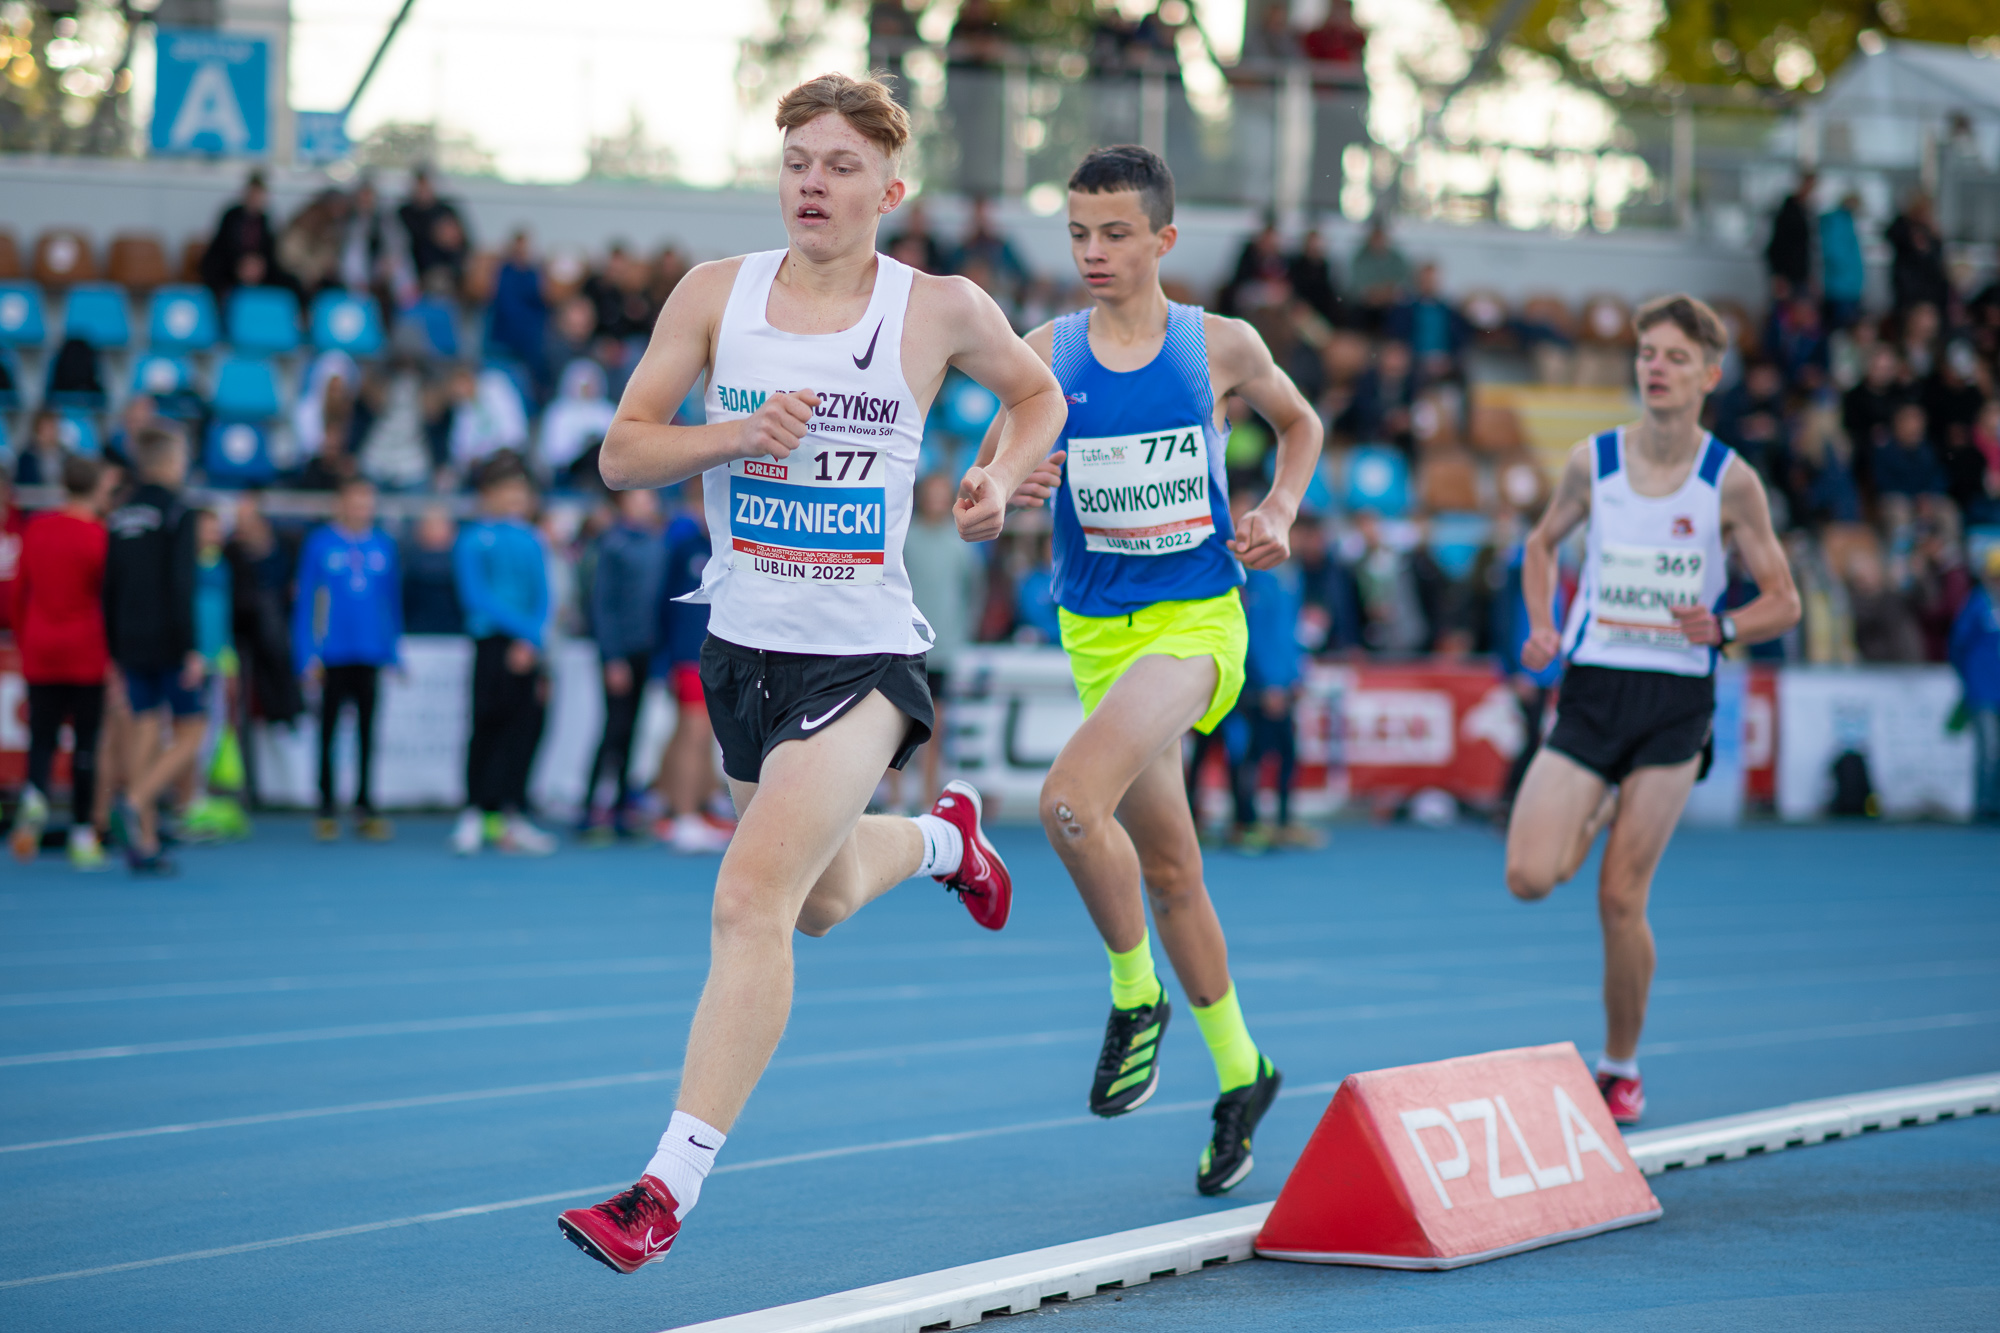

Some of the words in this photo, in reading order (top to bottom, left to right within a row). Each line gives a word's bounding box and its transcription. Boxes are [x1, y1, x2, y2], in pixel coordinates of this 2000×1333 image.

[168, 62, 252, 147] A
[717, 384, 766, 414] ADAM
[775, 388, 900, 424] CZYŃSKI
[819, 422, 846, 433] Team
[848, 425, 877, 436] Nowa
[879, 427, 894, 436] Sól
[1140, 432, 1198, 465] 774
[746, 463, 785, 479] ORLEN
[814, 451, 878, 481] 177
[1078, 476, 1204, 513] SŁOWIKOWSKI
[735, 492, 881, 534] ZDZYNIECKI
[771, 547, 816, 558] MISTRZOSTWA
[1106, 538, 1151, 551] LUBLIN
[1155, 532, 1192, 549] 2022
[754, 558, 806, 578] LUBLIN
[811, 566, 855, 580] 2022
[788, 555, 819, 563] JANUSZA
[1655, 553, 1702, 577] 369
[1399, 1085, 1624, 1210] PZLA
